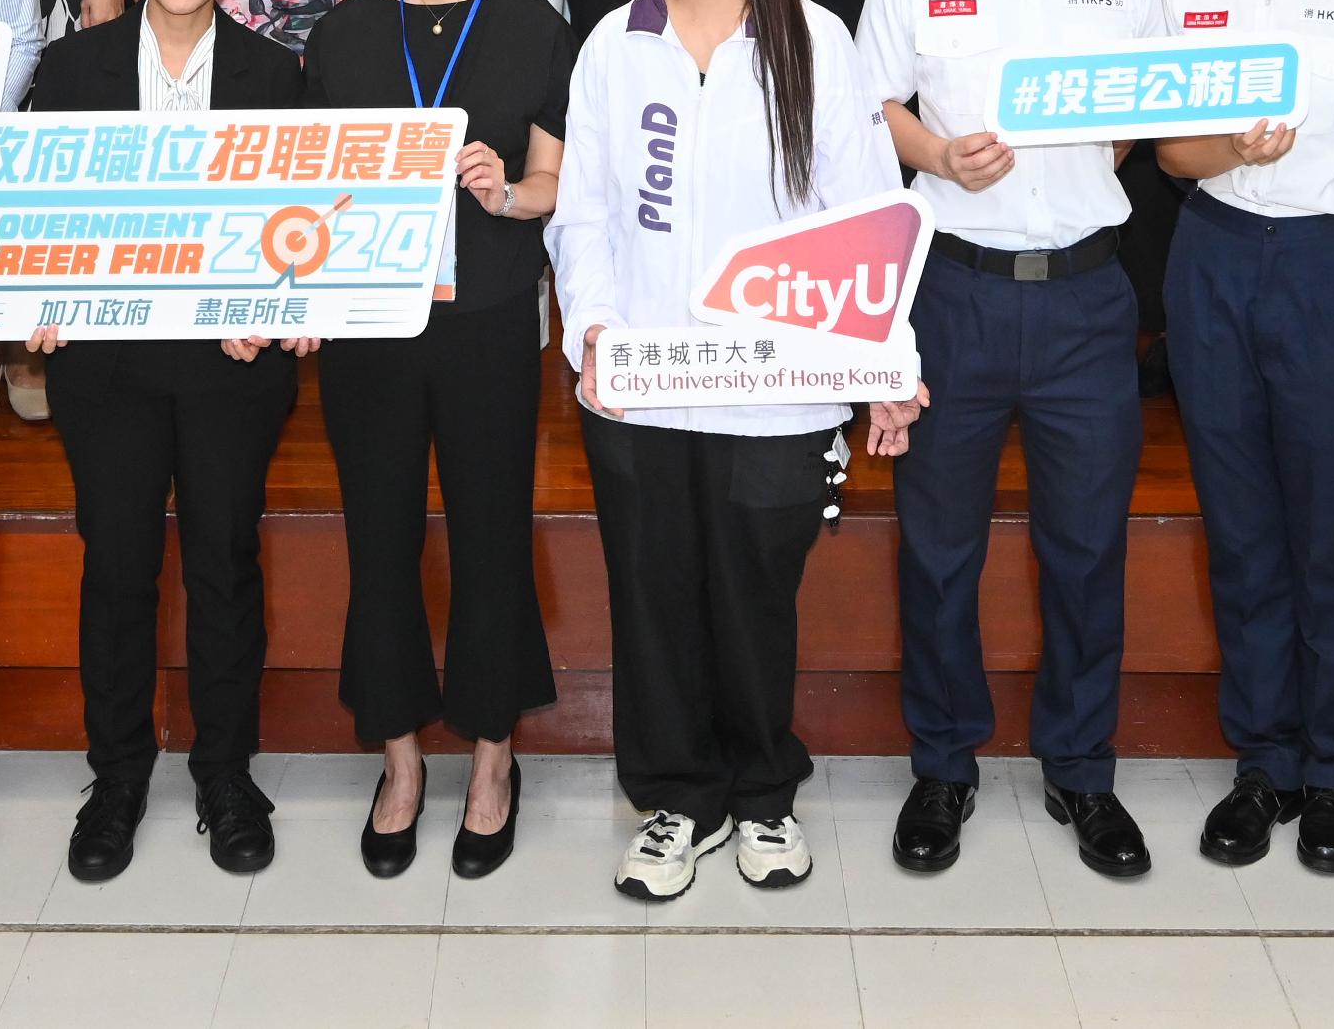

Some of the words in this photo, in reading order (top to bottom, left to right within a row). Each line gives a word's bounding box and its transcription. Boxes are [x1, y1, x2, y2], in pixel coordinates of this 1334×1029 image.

[1013, 56, 1286, 117] #投考公務員
[637, 102, 678, 234] PlanD
[108, 244, 205, 275] FAIR
[208, 205, 437, 279] 2024
[36, 299, 151, 327] 加入政府
[193, 297, 310, 327] 盡展所長
[730, 262, 899, 333] CityU
[610, 340, 777, 367] 香港城市大學
[610, 374, 652, 397] City
[657, 370, 758, 394] University
[764, 368, 787, 388] of
[791, 369, 844, 391] Hong
[849, 367, 902, 389] Kong
